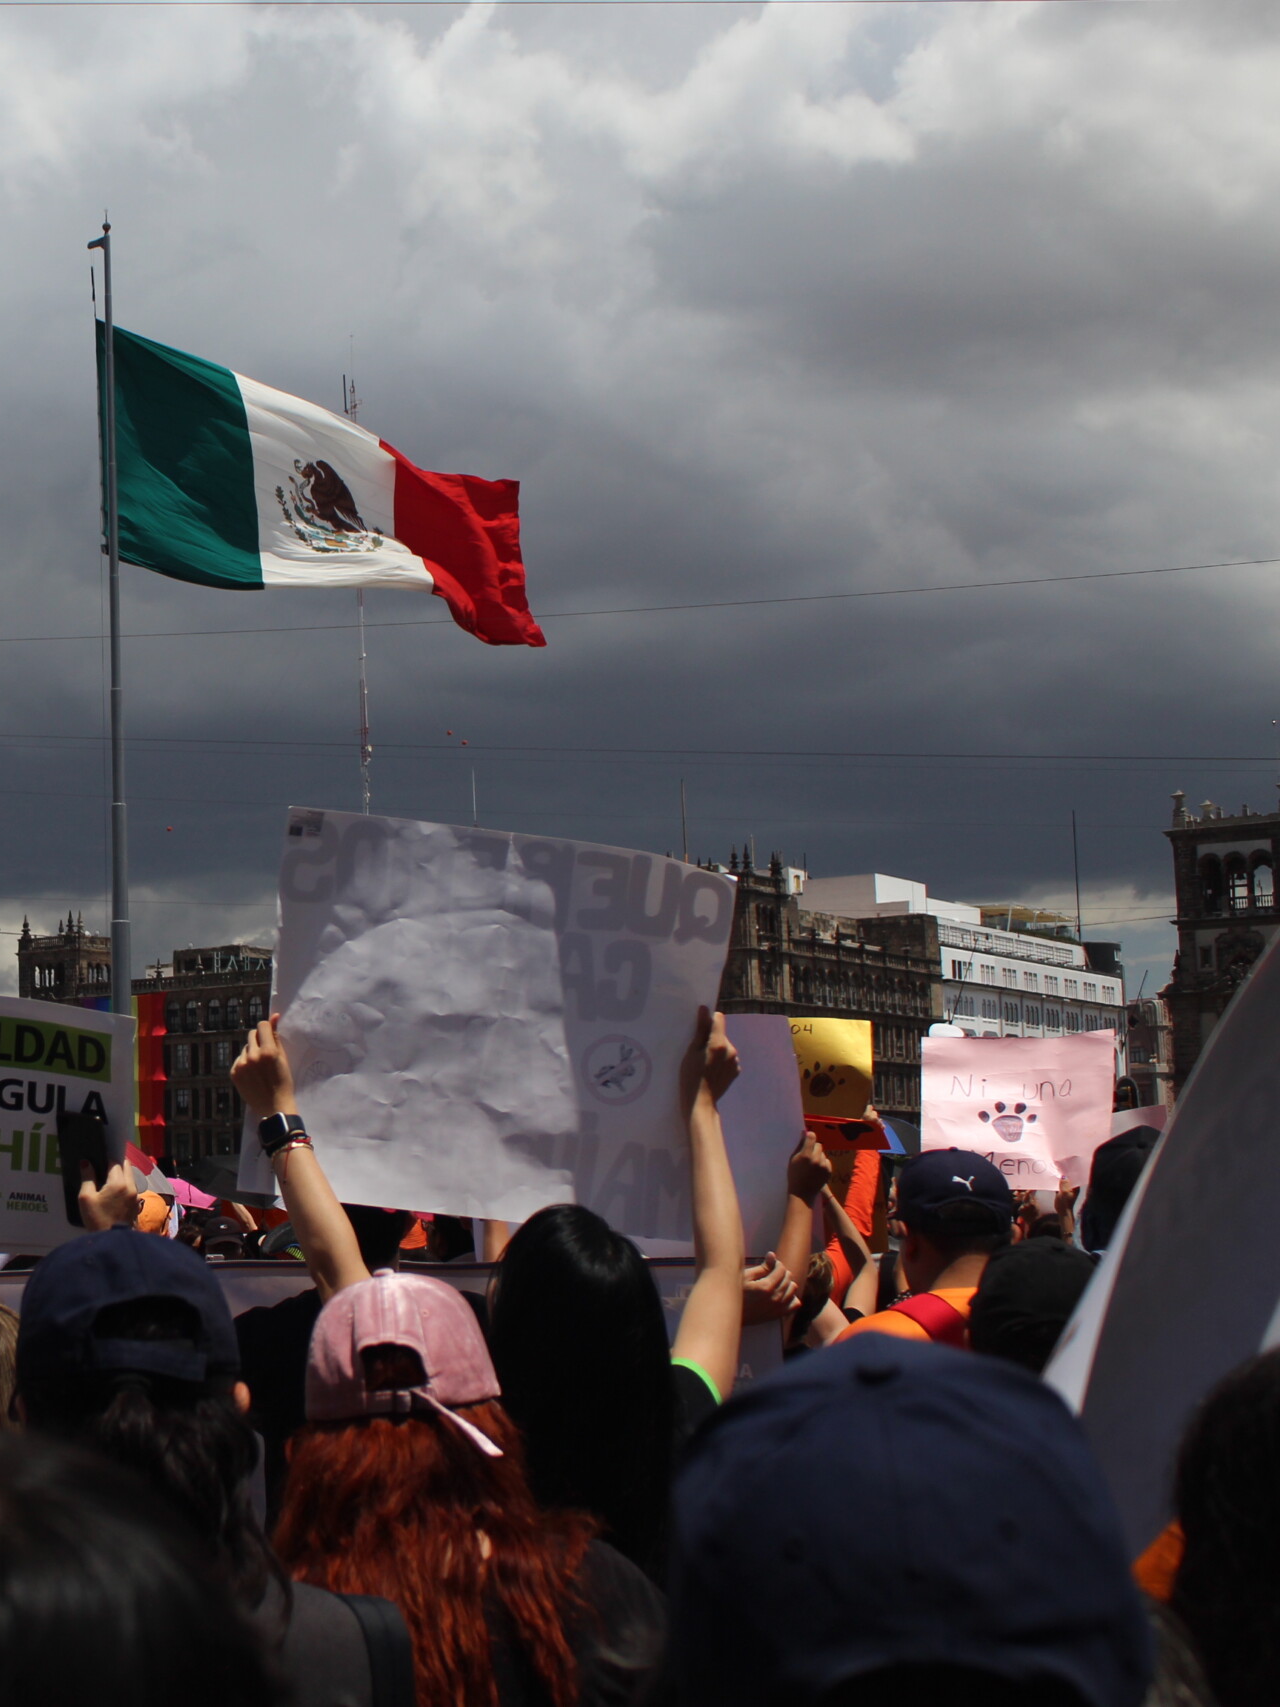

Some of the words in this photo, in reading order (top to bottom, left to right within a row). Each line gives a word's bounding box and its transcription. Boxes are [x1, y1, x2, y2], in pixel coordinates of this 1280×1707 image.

[950, 1074, 987, 1098] Ni
[1022, 1076, 1073, 1102] una
[9, 1191, 47, 1203] ANIMAL
[6, 1201, 49, 1213] HEROES
